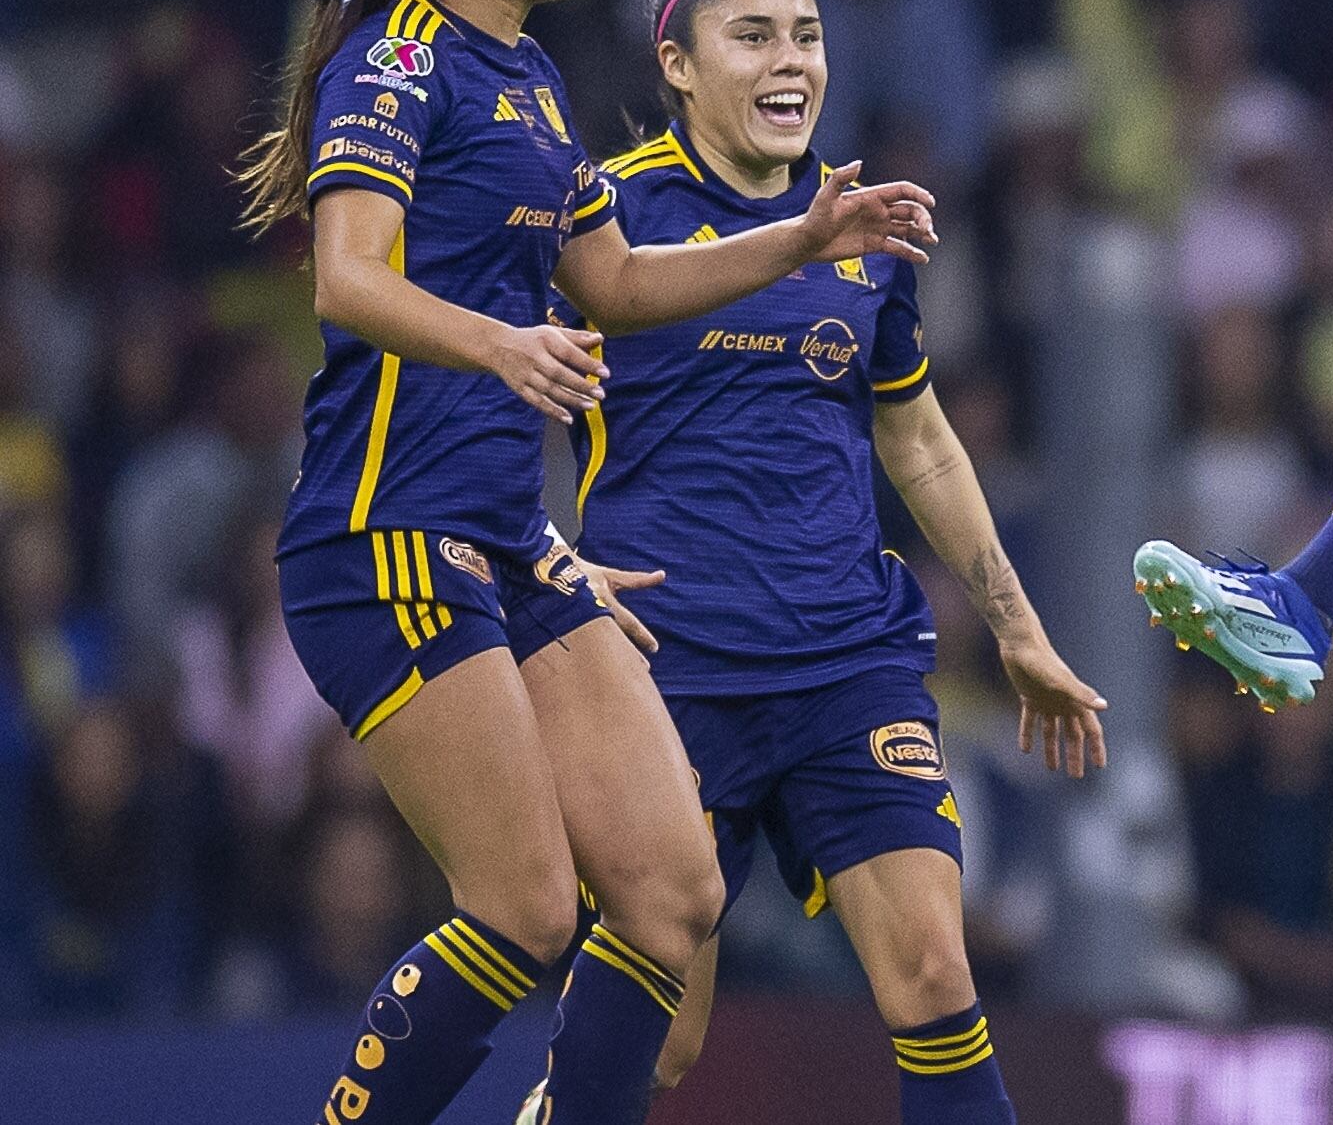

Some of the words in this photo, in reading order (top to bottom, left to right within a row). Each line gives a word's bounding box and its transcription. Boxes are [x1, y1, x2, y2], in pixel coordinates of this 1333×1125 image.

[329, 115, 378, 129] HOGAR
[722, 334, 787, 352] CEMEX
[800, 334, 853, 363] Vertua
